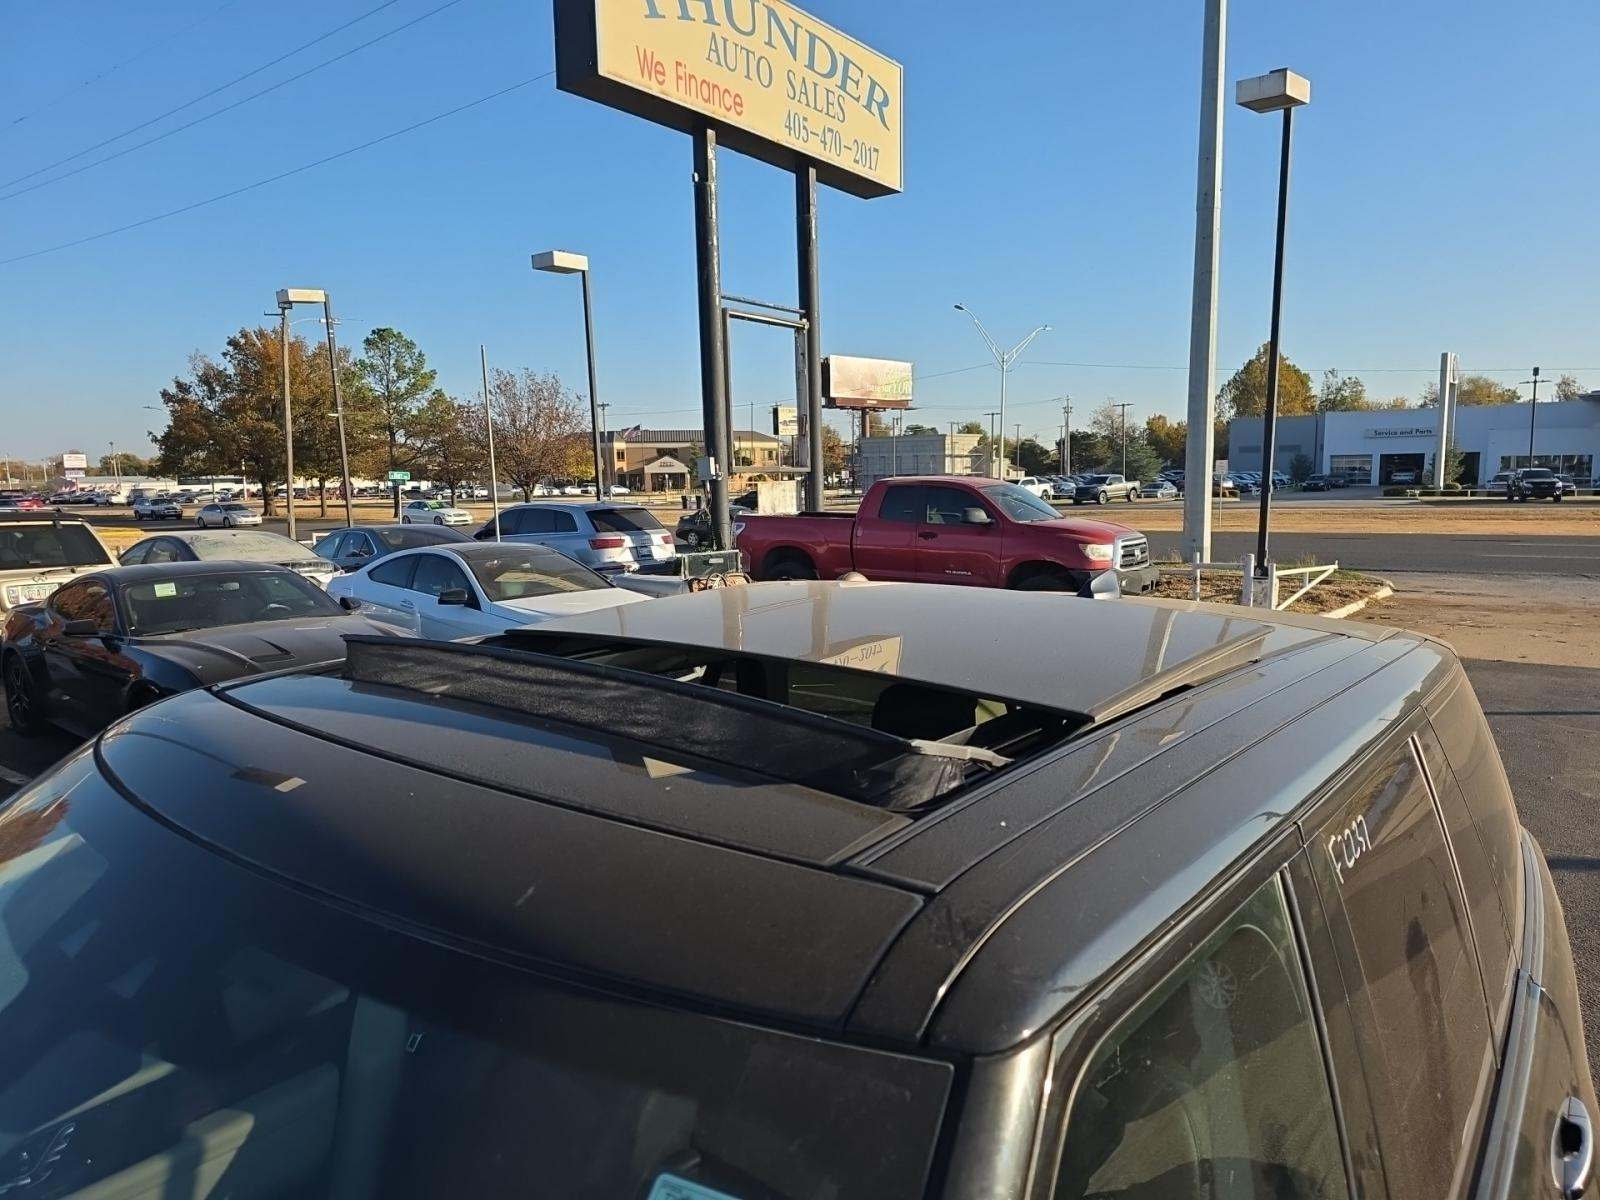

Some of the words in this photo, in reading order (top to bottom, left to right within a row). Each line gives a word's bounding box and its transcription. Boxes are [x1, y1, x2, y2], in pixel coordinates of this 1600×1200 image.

[635, 45, 667, 86] We
[675, 60, 745, 117] Finance
[706, 31, 774, 89] AUTO
[786, 68, 847, 124] SALES
[784, 109, 880, 172] 405-470-2017
[1374, 428, 1398, 436] Service
